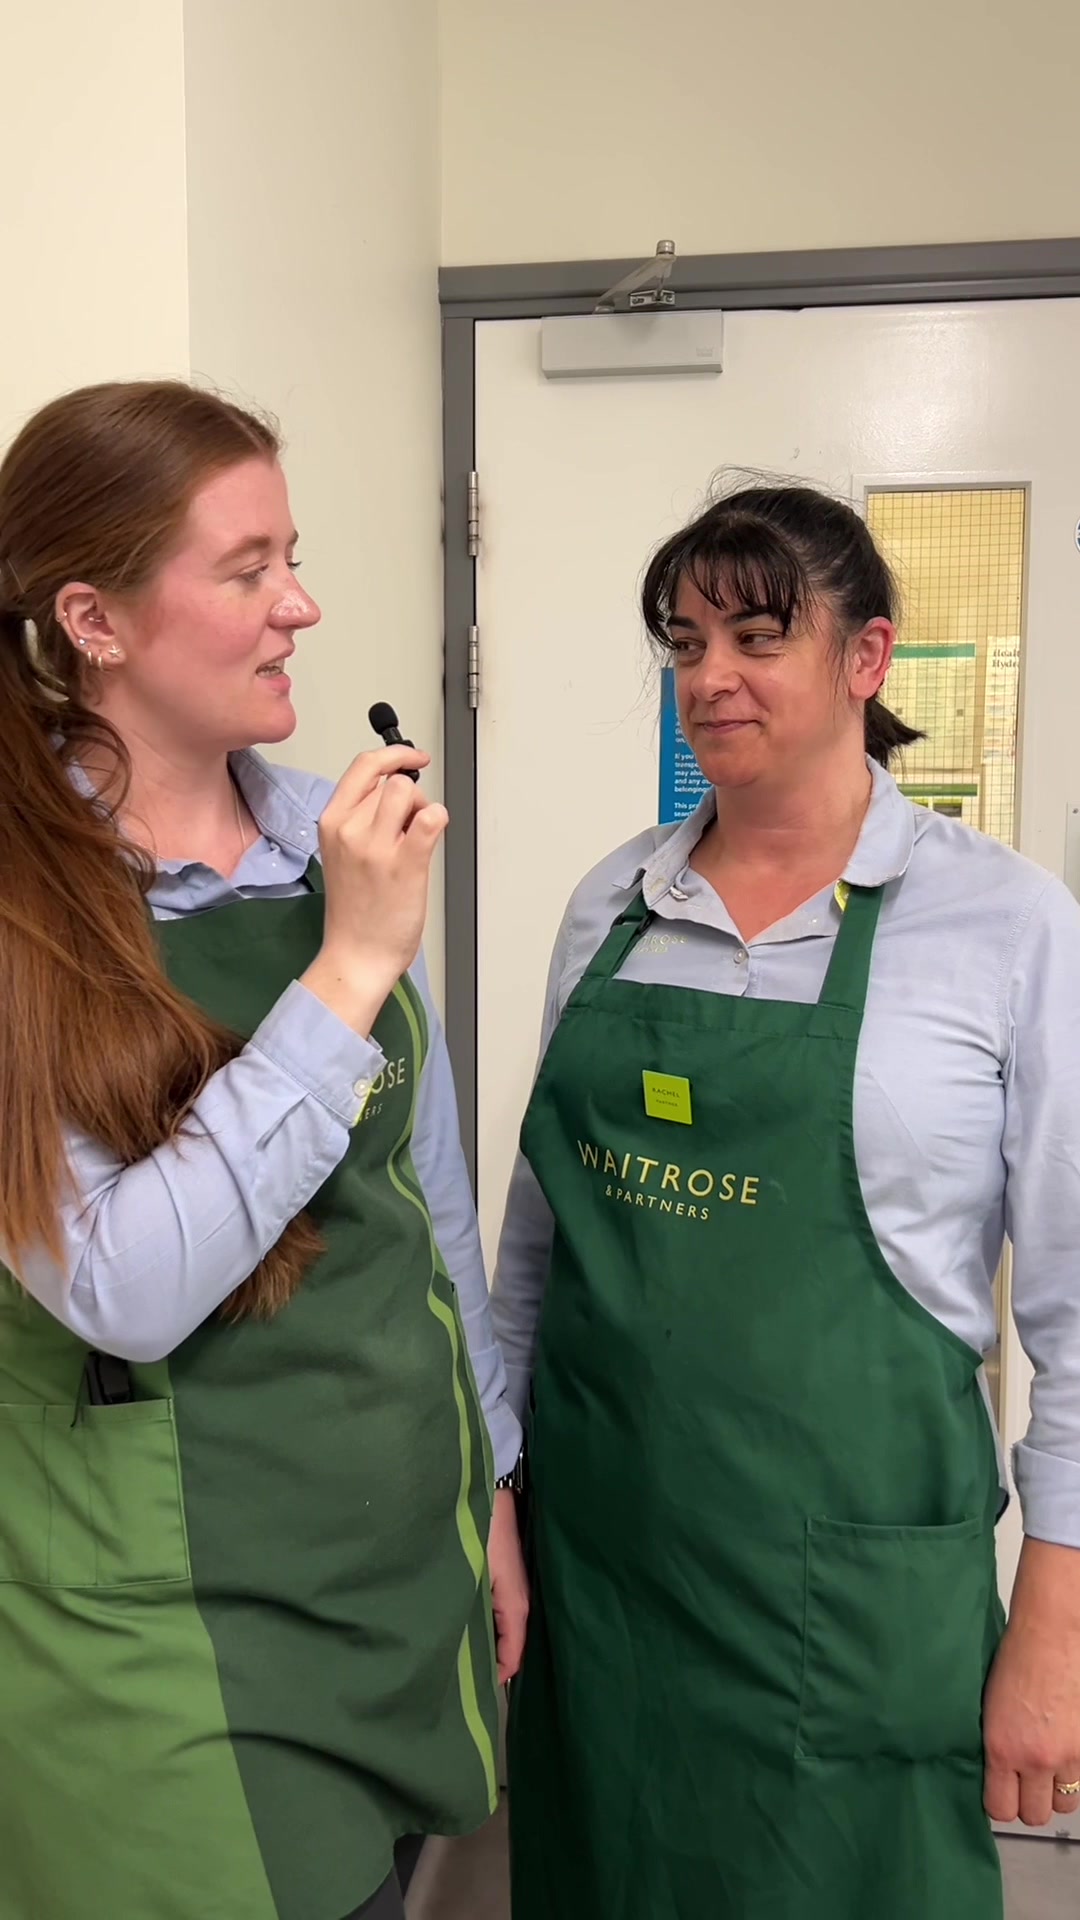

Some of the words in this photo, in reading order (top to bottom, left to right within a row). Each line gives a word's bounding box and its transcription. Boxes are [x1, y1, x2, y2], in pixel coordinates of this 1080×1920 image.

[992, 659, 1019, 669] Hydr
[652, 1088, 680, 1098] RACHEL
[577, 1139, 760, 1205] WAITROSE
[605, 1184, 612, 1196] &
[616, 1188, 709, 1220] PARTNERS
